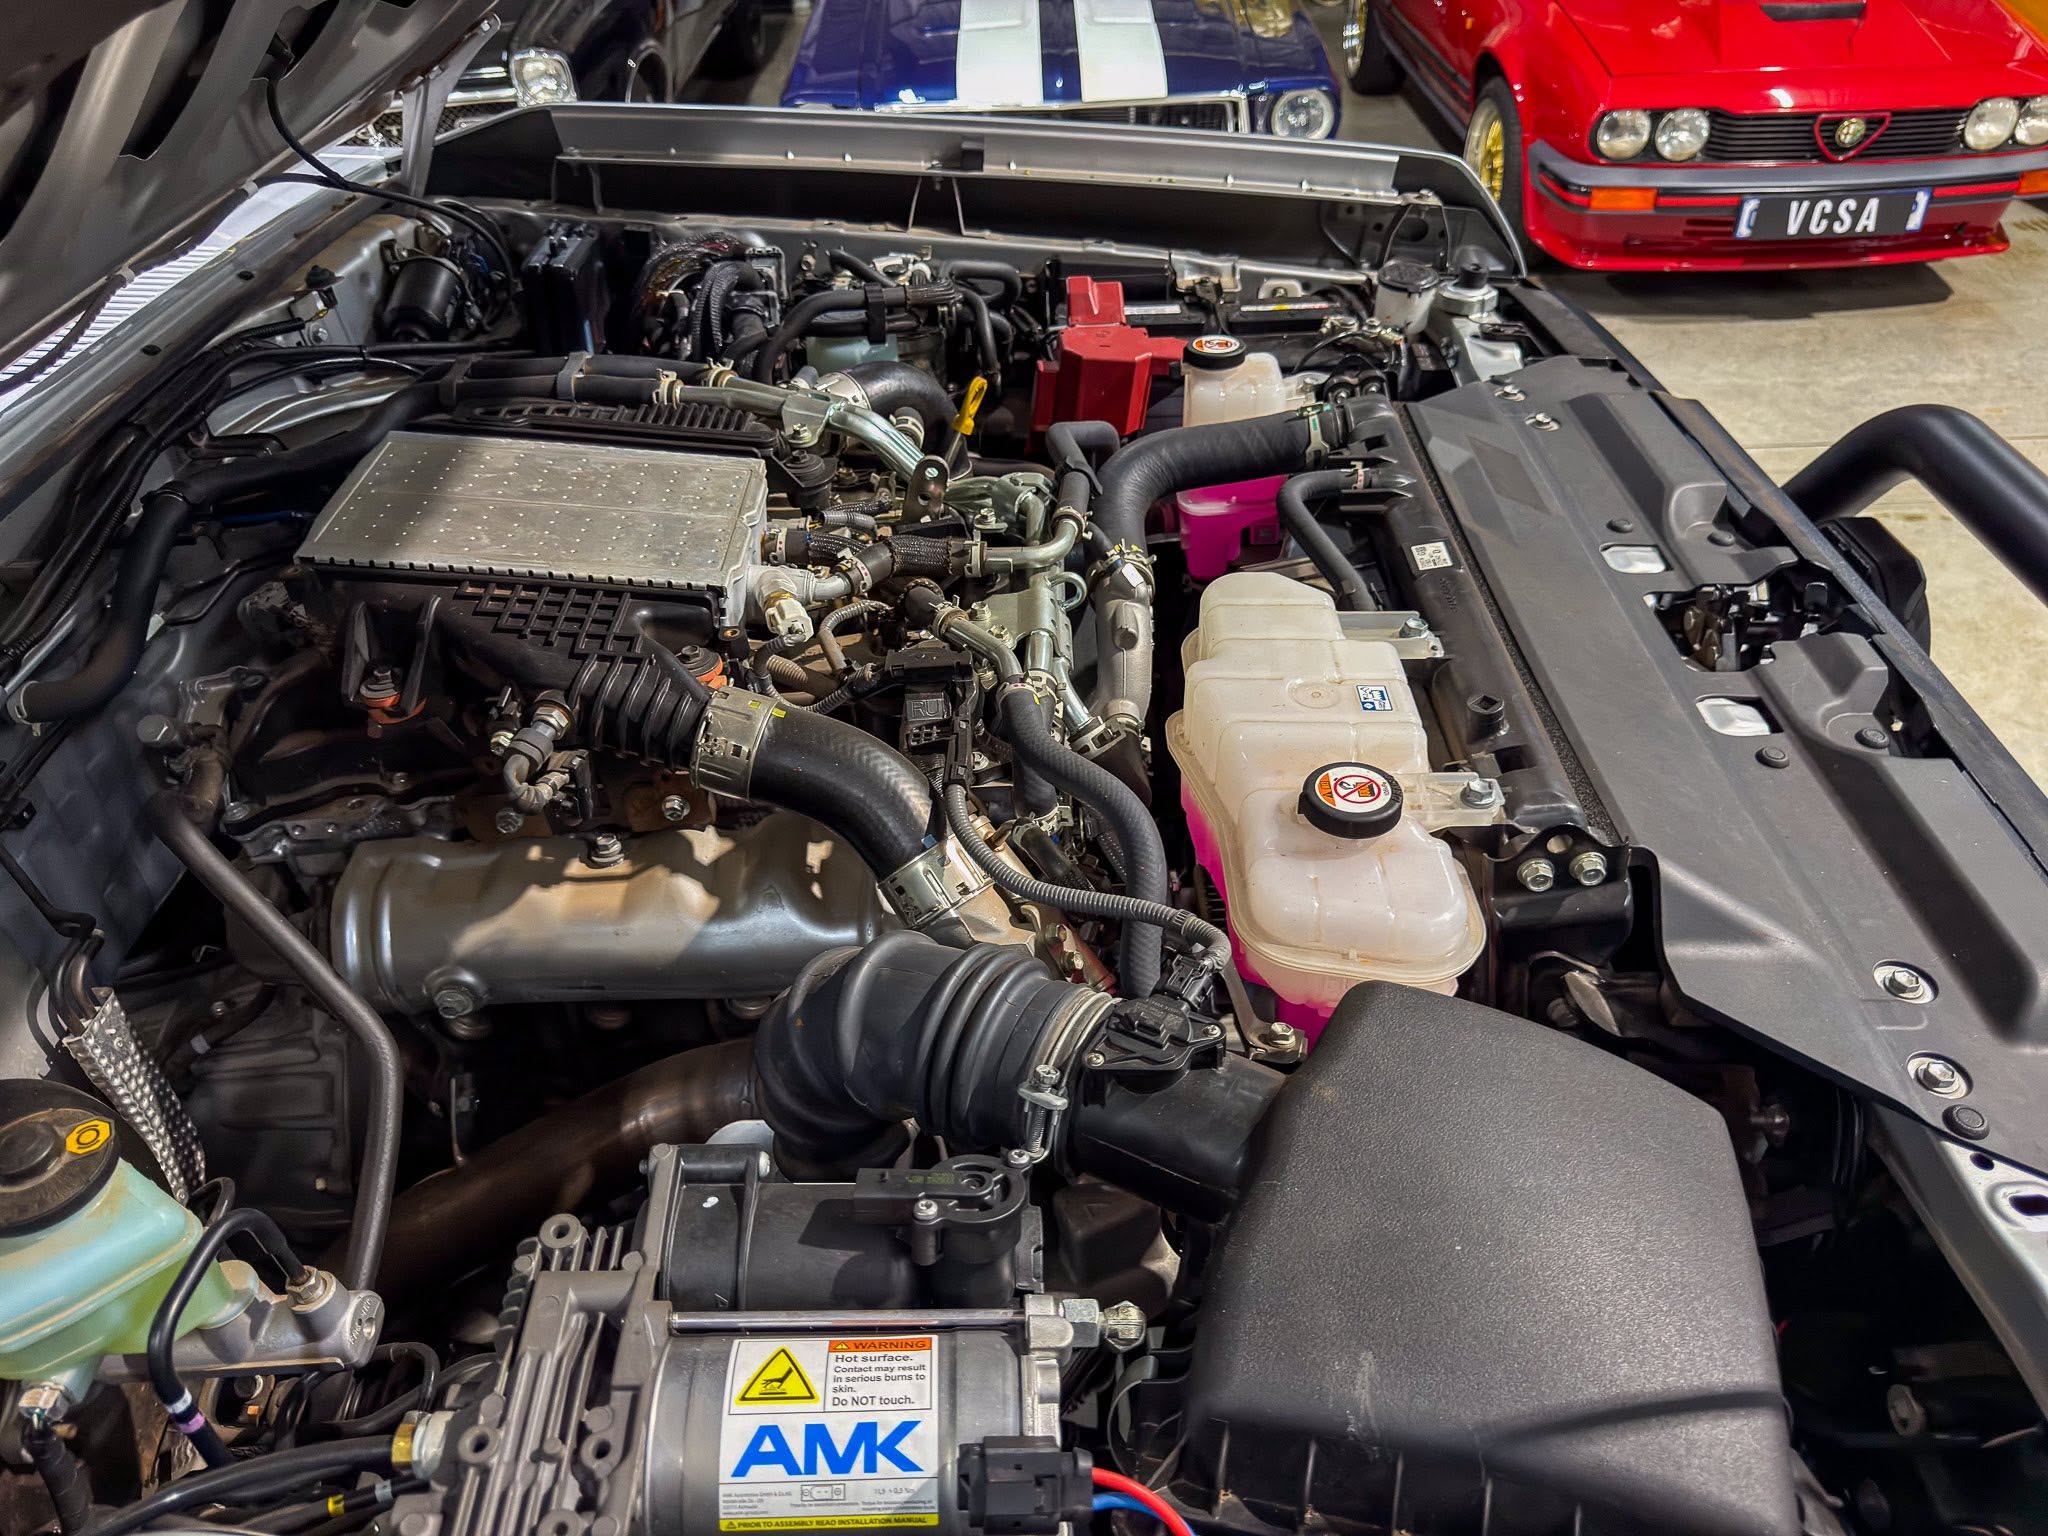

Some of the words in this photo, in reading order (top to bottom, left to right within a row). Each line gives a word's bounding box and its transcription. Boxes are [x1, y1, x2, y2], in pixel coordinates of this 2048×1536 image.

[1786, 197, 1880, 236] VCSA
[853, 1341, 926, 1349] WARNING
[835, 1354, 858, 1363] Hot
[861, 1354, 914, 1363] surface.
[833, 1365, 873, 1373] Contact
[898, 1364, 926, 1372] result
[833, 1375, 843, 1383] in
[845, 1374, 882, 1383] serious
[884, 1373, 913, 1382] burns
[915, 1373, 926, 1381] to
[832, 1385, 857, 1393] skin.
[832, 1397, 848, 1407] Do
[851, 1396, 877, 1406] NOT
[879, 1395, 916, 1405] touch.
[731, 1420, 925, 1478] AMK
[737, 1521, 762, 1529] PRIOR
[774, 1520, 814, 1528] ASSEMBLY
[838, 1518, 892, 1526] INSTALLATION
